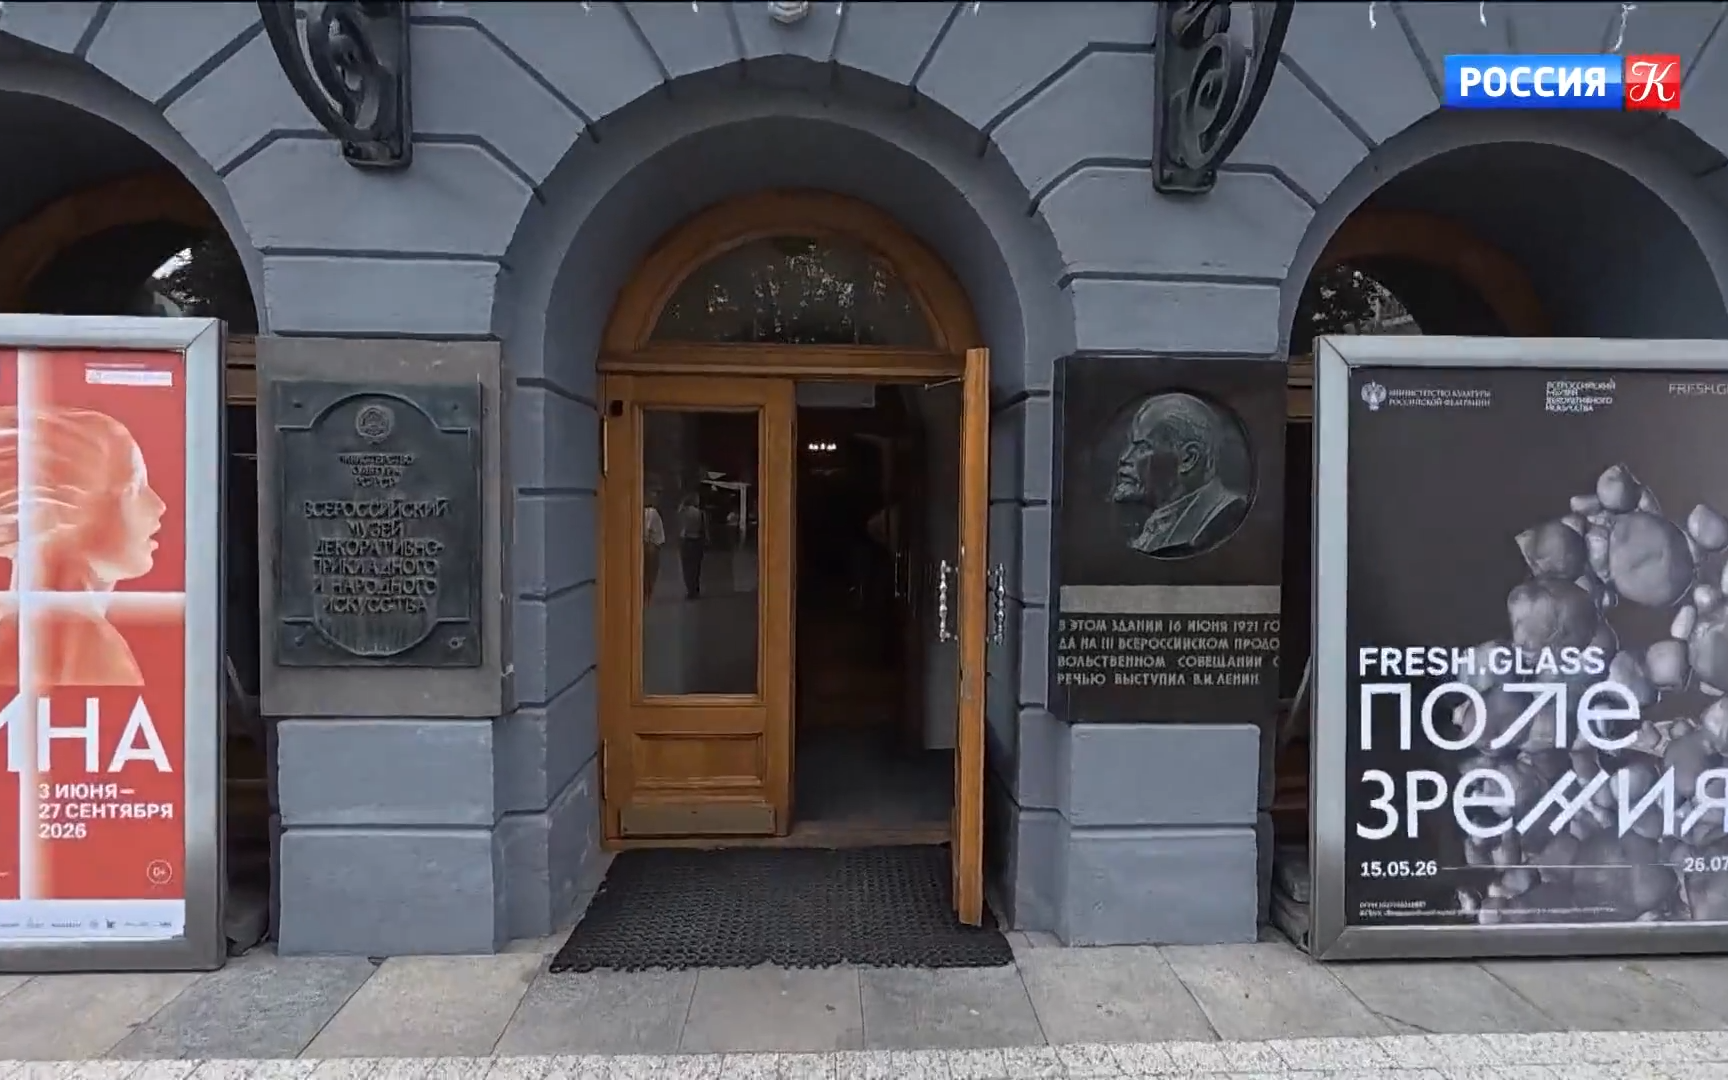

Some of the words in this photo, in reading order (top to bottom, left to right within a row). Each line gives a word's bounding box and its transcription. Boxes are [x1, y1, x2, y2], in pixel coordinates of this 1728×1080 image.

[332, 577, 439, 595] НАРОДНОГО
[1070, 619, 1107, 632] ЭТОМ
[1112, 619, 1163, 632] ЗДАНИИ
[1168, 619, 1182, 632] 16
[1187, 619, 1228, 632] ИЮНЯ
[1233, 620, 1258, 632] 1921
[1263, 620, 1280, 632] ГО
[1058, 636, 1076, 650] ДА
[1080, 636, 1097, 650] НА
[1101, 636, 1114, 650] III
[1234, 637, 1280, 650] ПРОДО
[1057, 655, 1166, 668] ВОЛЬСТВЕННОМ
[1177, 654, 1262, 668] СОВЕЩАНИИ
[1359, 646, 1606, 677] FRESH.GLASS
[1057, 672, 1106, 685] РЕЧЬЮ
[1114, 672, 1185, 685] ВЫСТУПИЛ
[1216, 673, 1260, 686] ЛЕНИН
[38, 783, 50, 799] 3
[38, 803, 63, 819] 27
[65, 803, 173, 819] СЕНТЯБРЯ
[38, 823, 87, 839] 2026
[1360, 861, 1438, 878] 15.05.26
